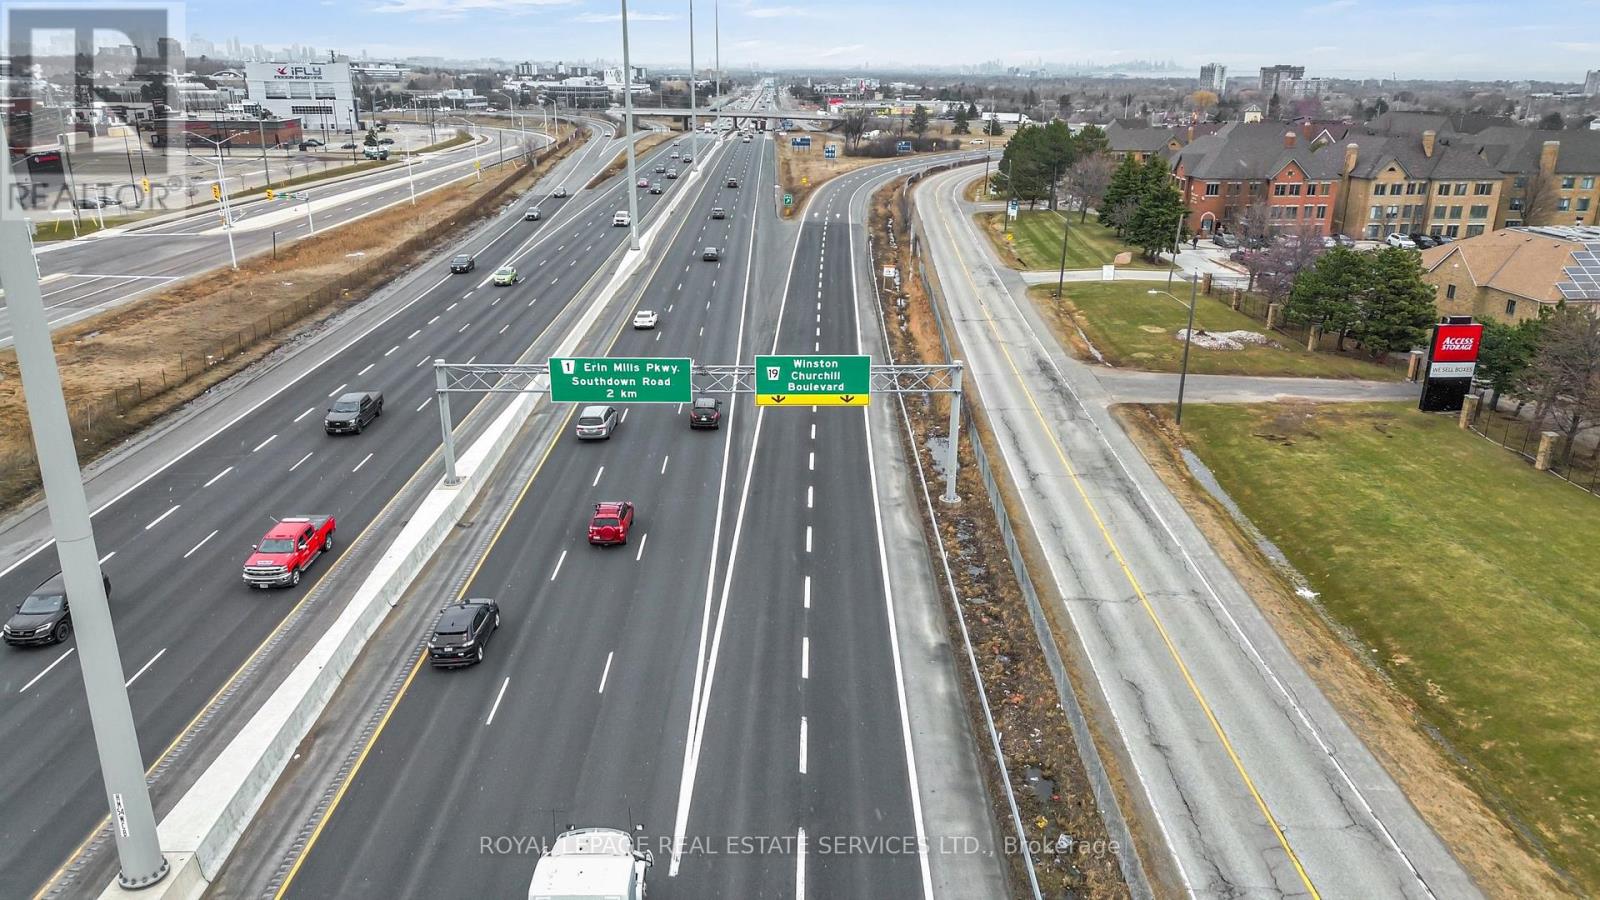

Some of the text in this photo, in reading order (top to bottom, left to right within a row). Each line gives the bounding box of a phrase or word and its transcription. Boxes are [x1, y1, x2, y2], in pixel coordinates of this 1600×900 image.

[291, 67, 322, 75] iFLY
[793, 359, 838, 368] Winston
[584, 363, 680, 374] Erin Mills Pkwy.
[768, 368, 778, 378] 19
[791, 371, 840, 380] Churchill
[572, 377, 671, 386] Southdown Road
[788, 382, 845, 391] Boulevard
[606, 389, 638, 398] 2 km
